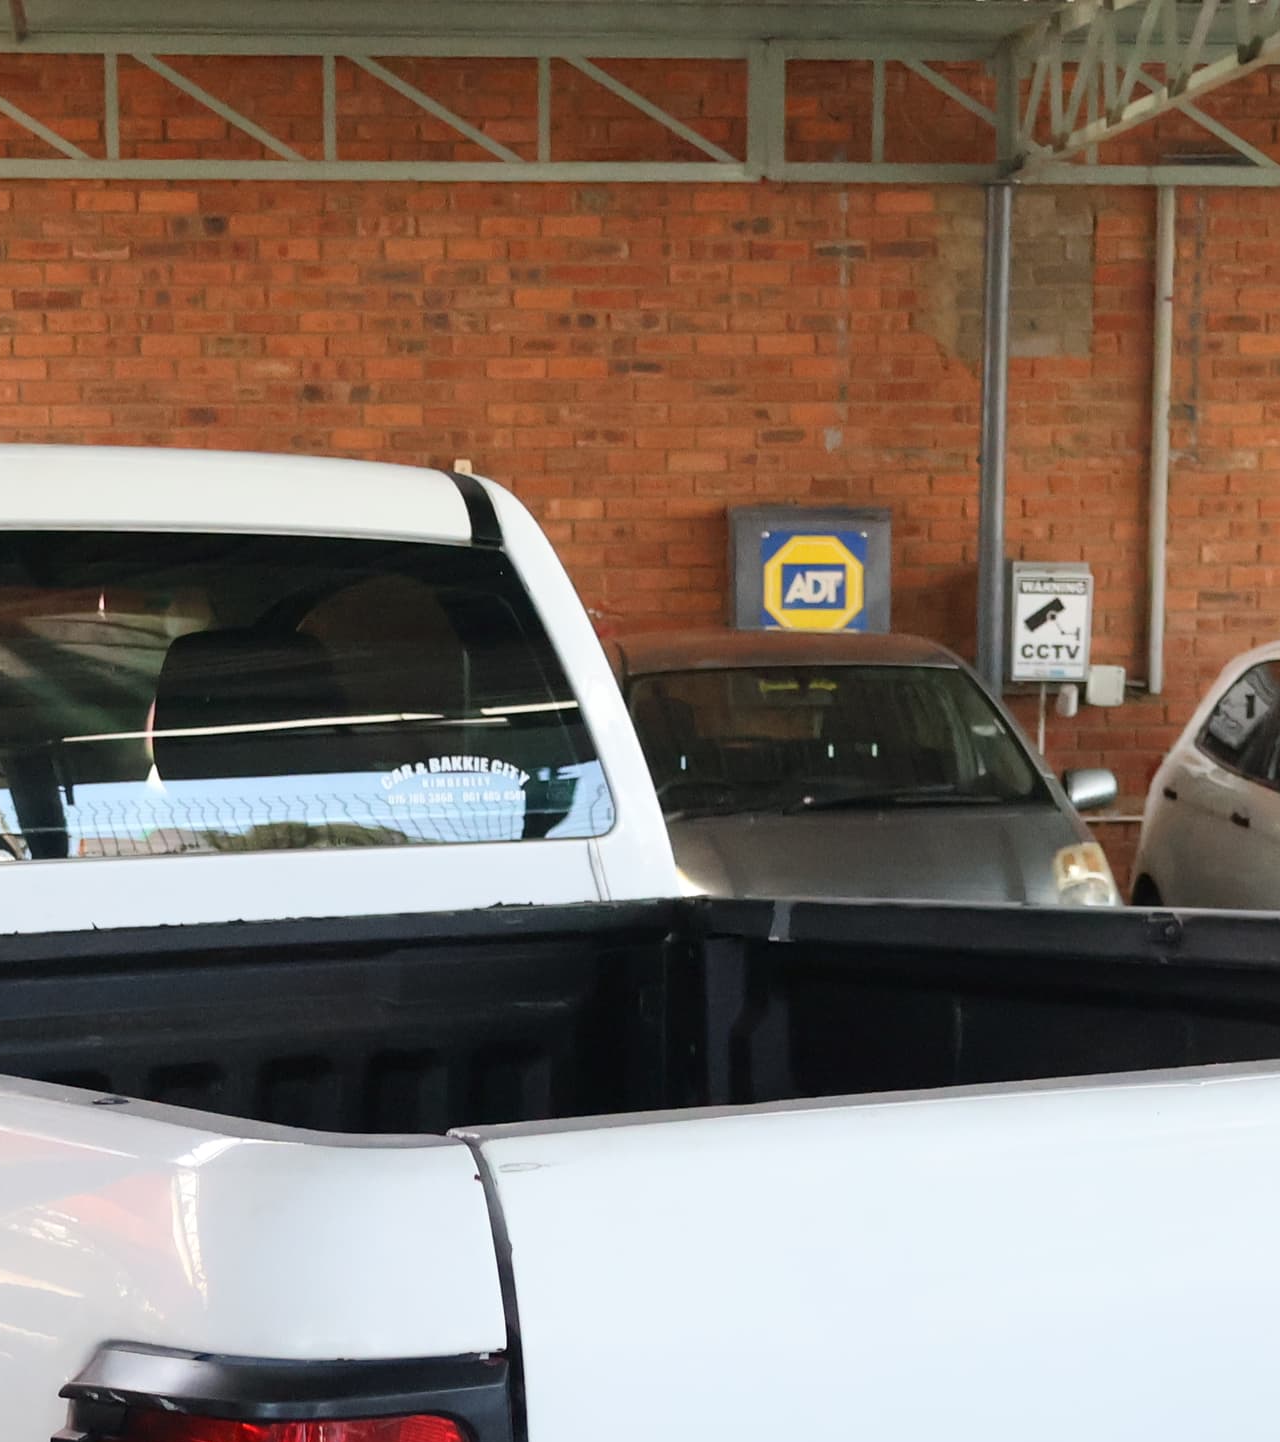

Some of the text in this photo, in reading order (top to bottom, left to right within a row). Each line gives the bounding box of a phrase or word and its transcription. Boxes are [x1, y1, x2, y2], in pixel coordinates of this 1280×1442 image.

[784, 570, 843, 604] ADT
[1022, 580, 1087, 594] WARNING
[1022, 644, 1080, 660] CCTV
[381, 755, 530, 790] CAR & BAKKIE CITY
[422, 777, 490, 788] KIMBERLEY
